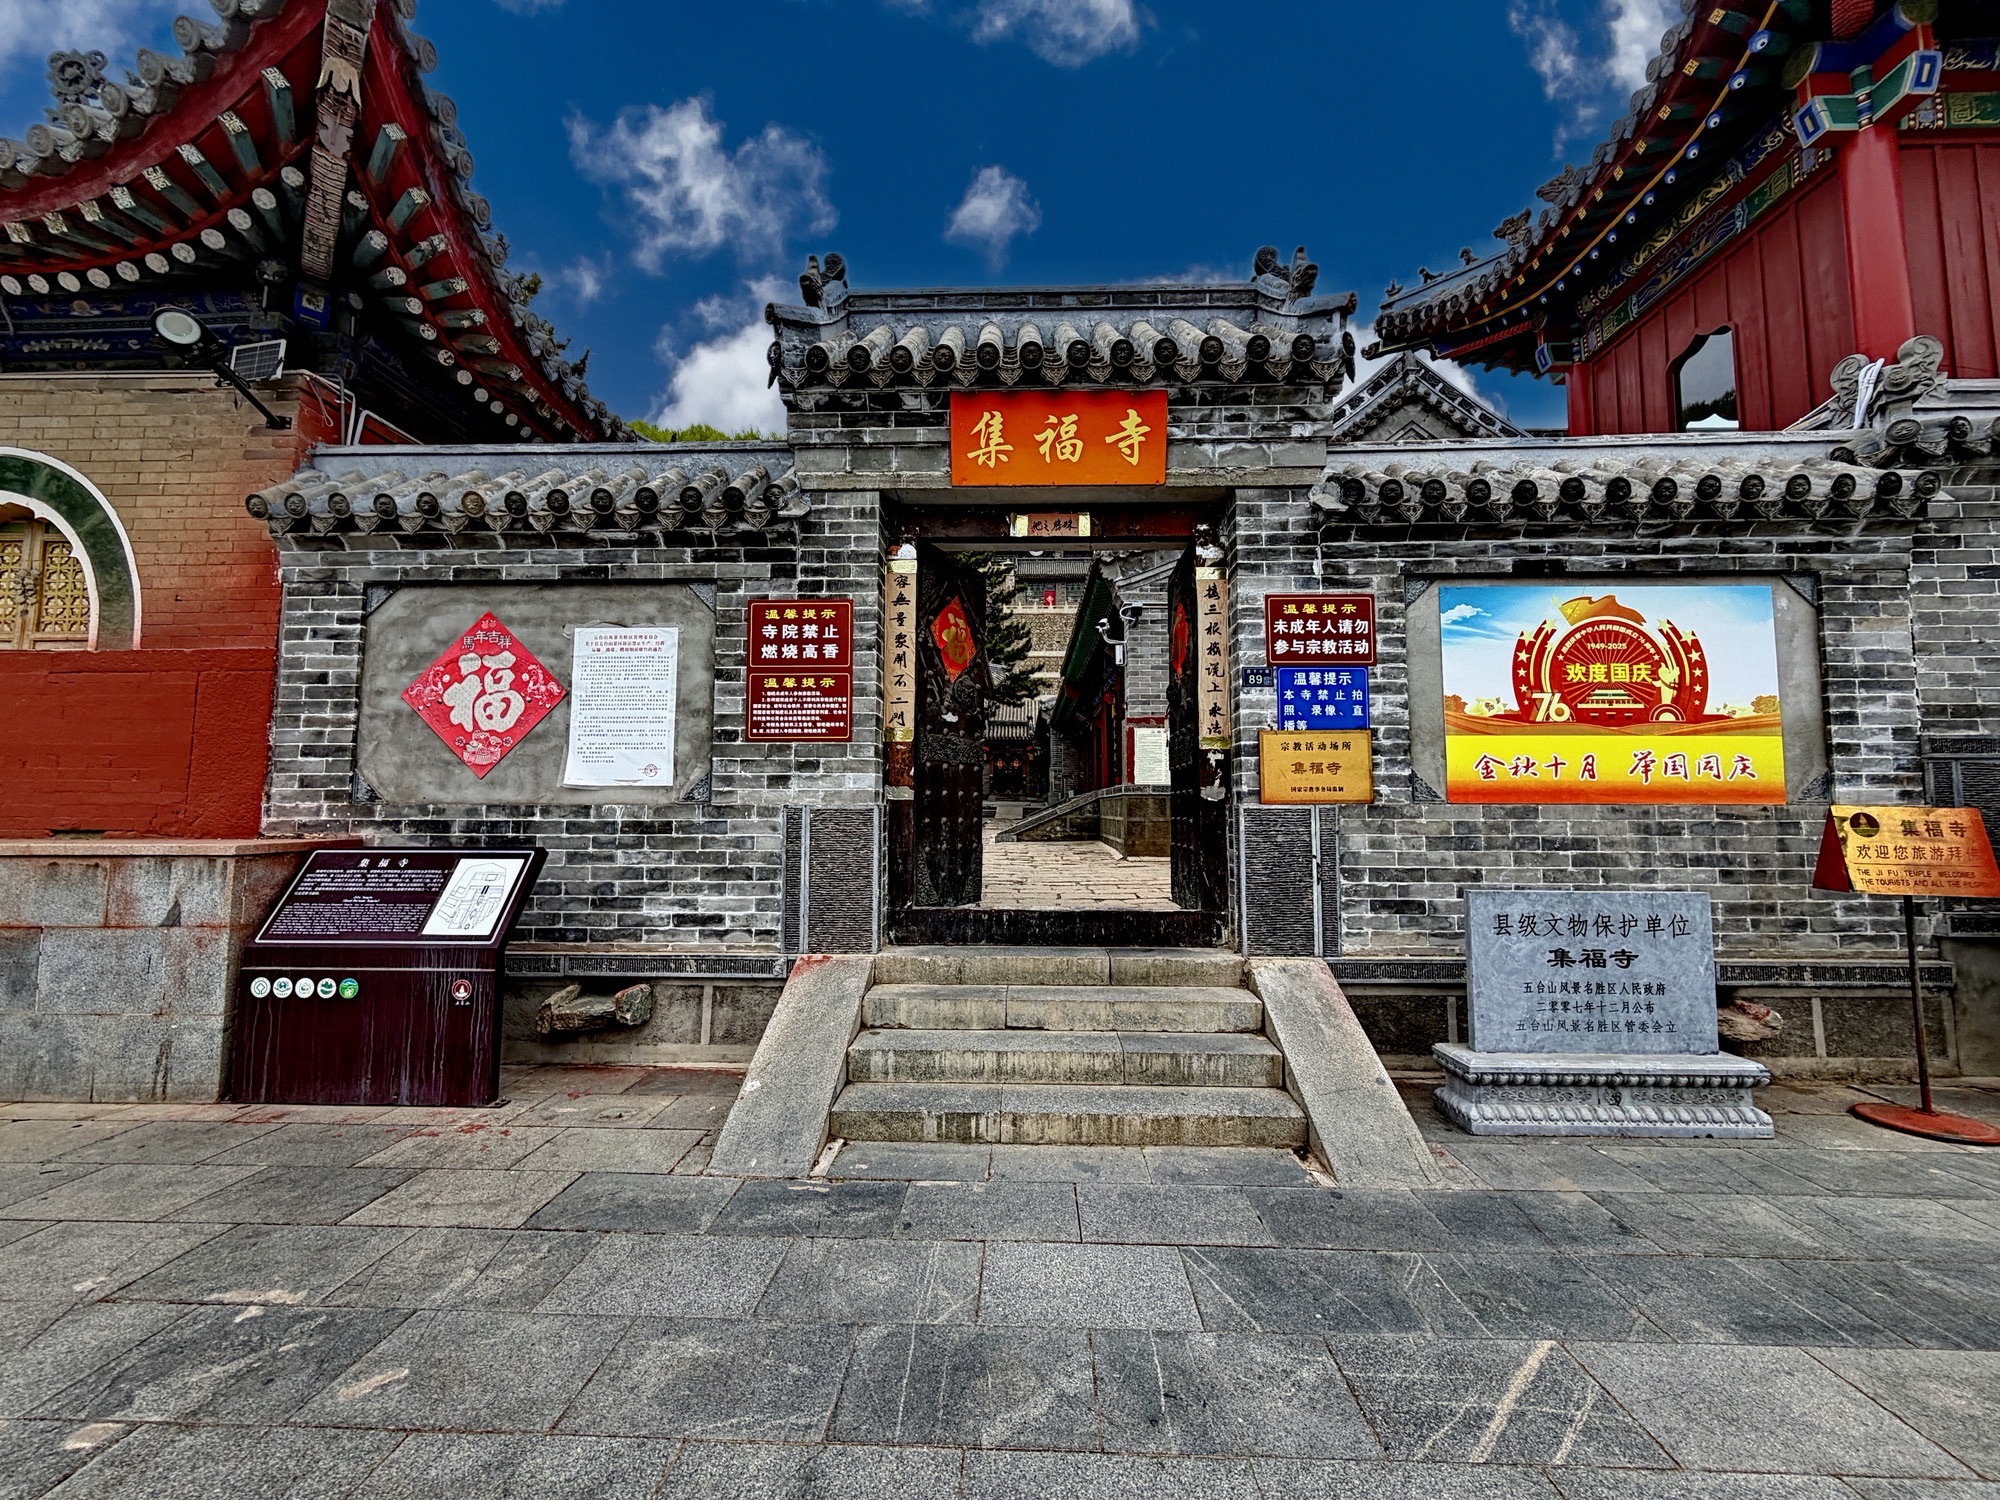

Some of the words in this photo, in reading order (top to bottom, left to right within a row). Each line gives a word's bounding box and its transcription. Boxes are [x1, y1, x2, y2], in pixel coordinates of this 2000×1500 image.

[966, 408, 1152, 469] 集福寺
[764, 608, 837, 620] 温馨提示
[1282, 603, 1357, 615] 温馨提示
[761, 623, 840, 640] 寺院禁止
[1273, 619, 1369, 635] 未成年人请勿
[462, 630, 513, 651] 馬年吉祥
[940, 613, 970, 666] 福
[1273, 639, 1369, 655] 参与宗教活动
[1586, 642, 1628, 650] 1949-2025
[760, 643, 839, 660] 燃烧高香
[1248, 674, 1263, 685] 89
[1293, 672, 1352, 686] 温馨提示
[1566, 662, 1653, 683] 欢度国庆
[763, 677, 836, 688] 温馨提示
[442, 650, 526, 733] 福
[1283, 689, 1363, 701] 本寺禁止拍
[1283, 704, 1364, 717] 照、录像、直
[1531, 692, 1571, 723] 76
[1280, 741, 1352, 752] 宗教活动场所
[1290, 761, 1342, 775] 集福寺
[1473, 753, 1599, 782] 金秋十月
[1627, 750, 1760, 785] 举国同庆
[1900, 819, 1967, 838] 集福寺
[357, 857, 410, 868] 集福寺
[1856, 868, 1871, 876] THE
[1904, 869, 1932, 878] TEMPLE
[1861, 878, 1874, 886] THE
[1876, 878, 1911, 886] TOURISTS
[1492, 912, 1692, 939] 县级文物保护单位
[1546, 947, 1640, 969] 集福寺
[1523, 981, 1666, 996] 五台山风景名胜区人民政府
[1536, 1001, 1655, 1015] 二零零七年十二月公布
[1515, 1018, 1678, 1034] 五台山风景名胜区管委会立
